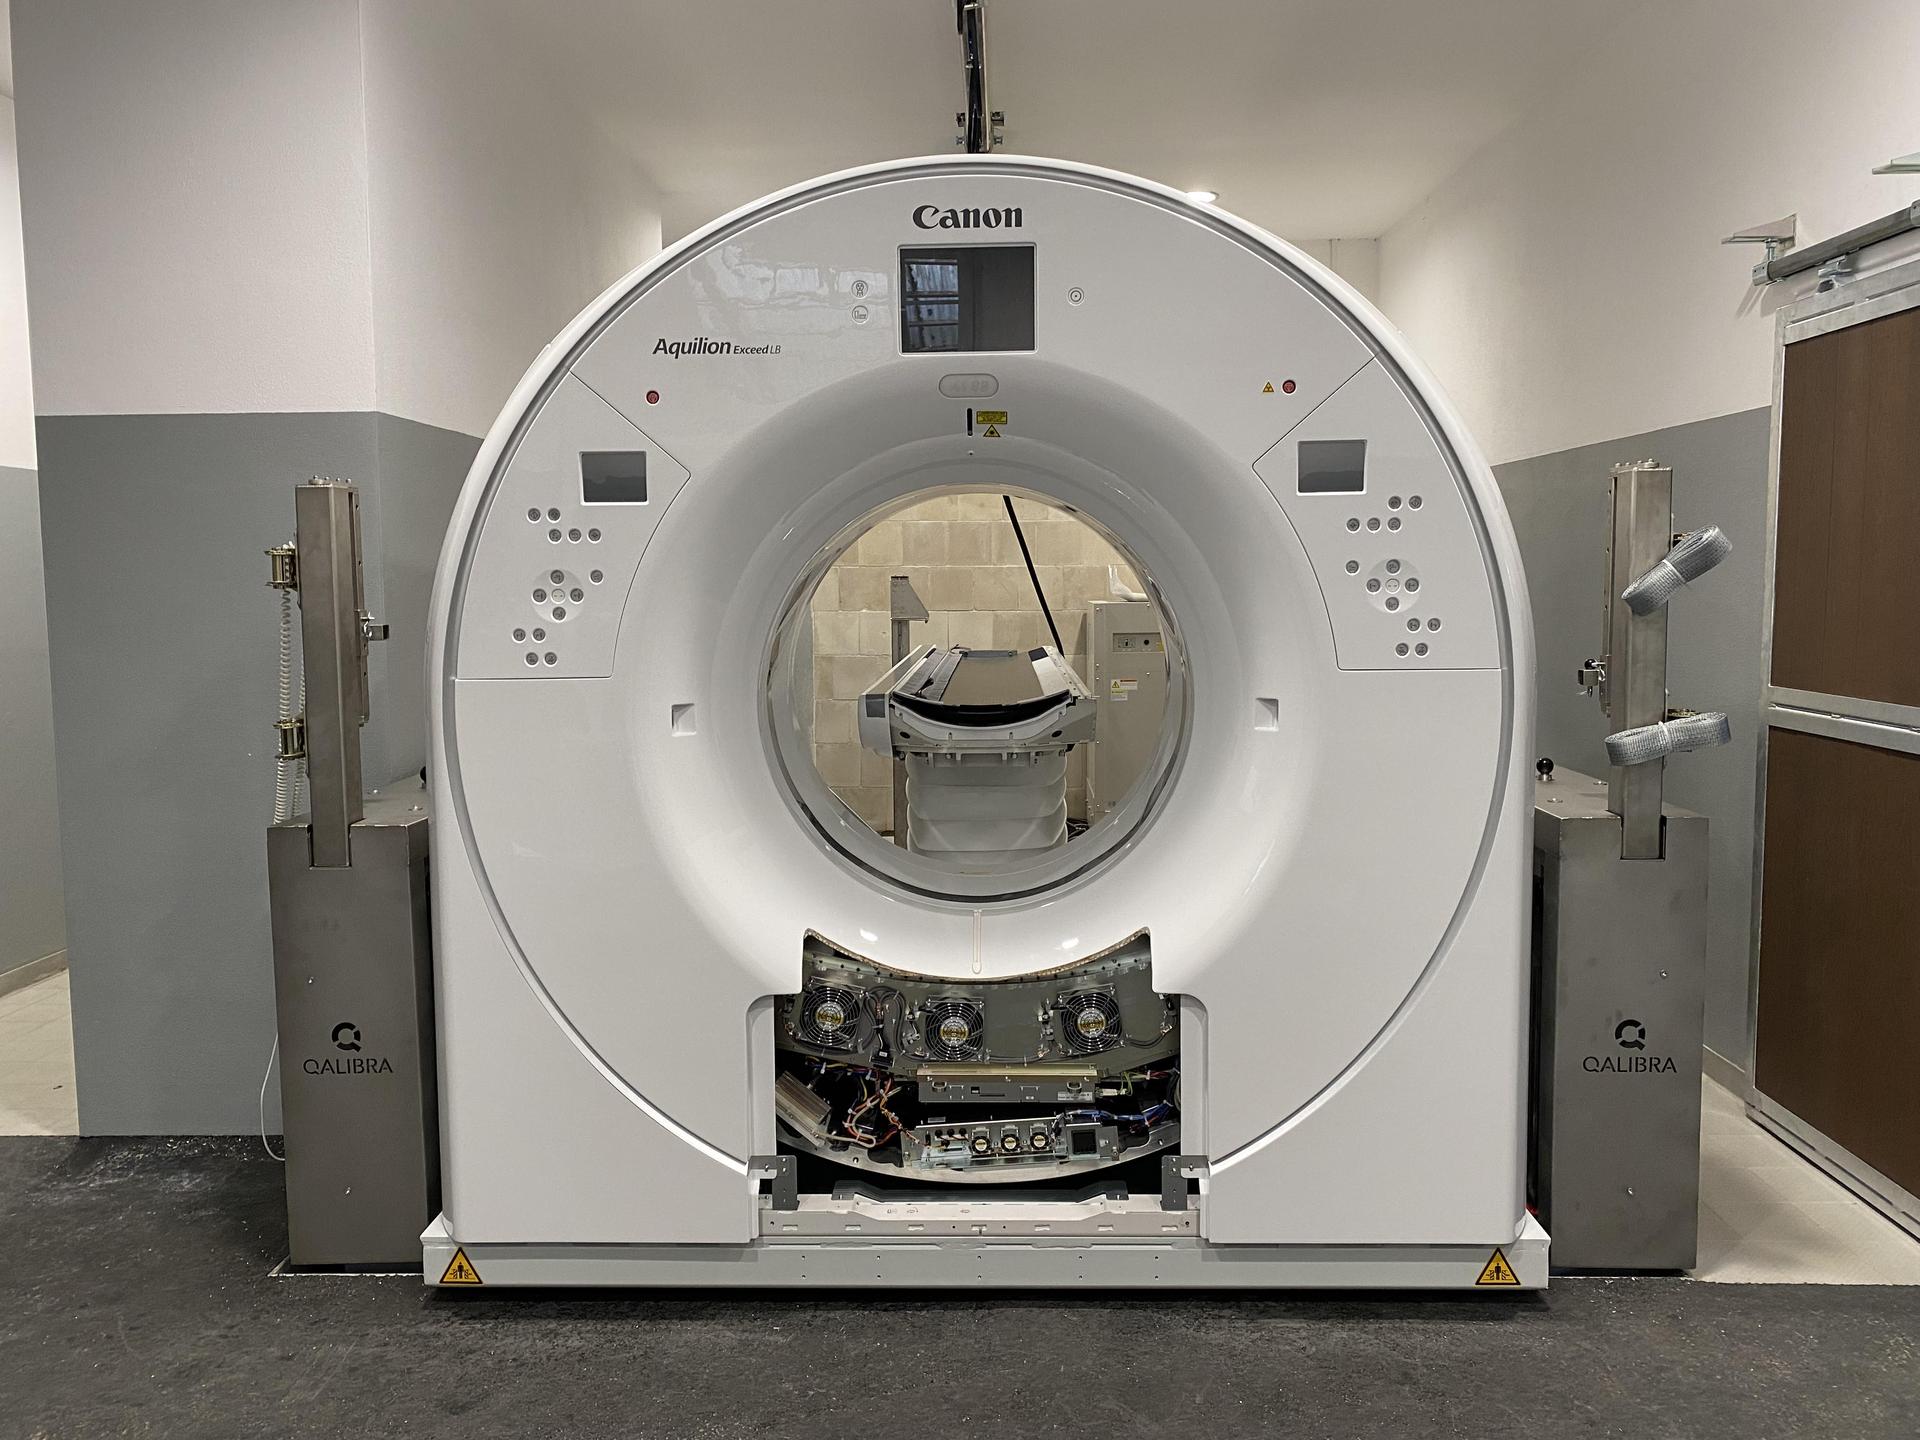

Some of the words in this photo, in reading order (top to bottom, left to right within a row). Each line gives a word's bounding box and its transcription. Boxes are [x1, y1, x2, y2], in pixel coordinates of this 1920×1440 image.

[912, 205, 1023, 230] Canon
[652, 337, 732, 359] Aquilion
[733, 345, 769, 355] Exceed
[769, 345, 781, 355] LB
[303, 1058, 394, 1075] QALIBRA
[1582, 1056, 1678, 1074] QALIBRA
